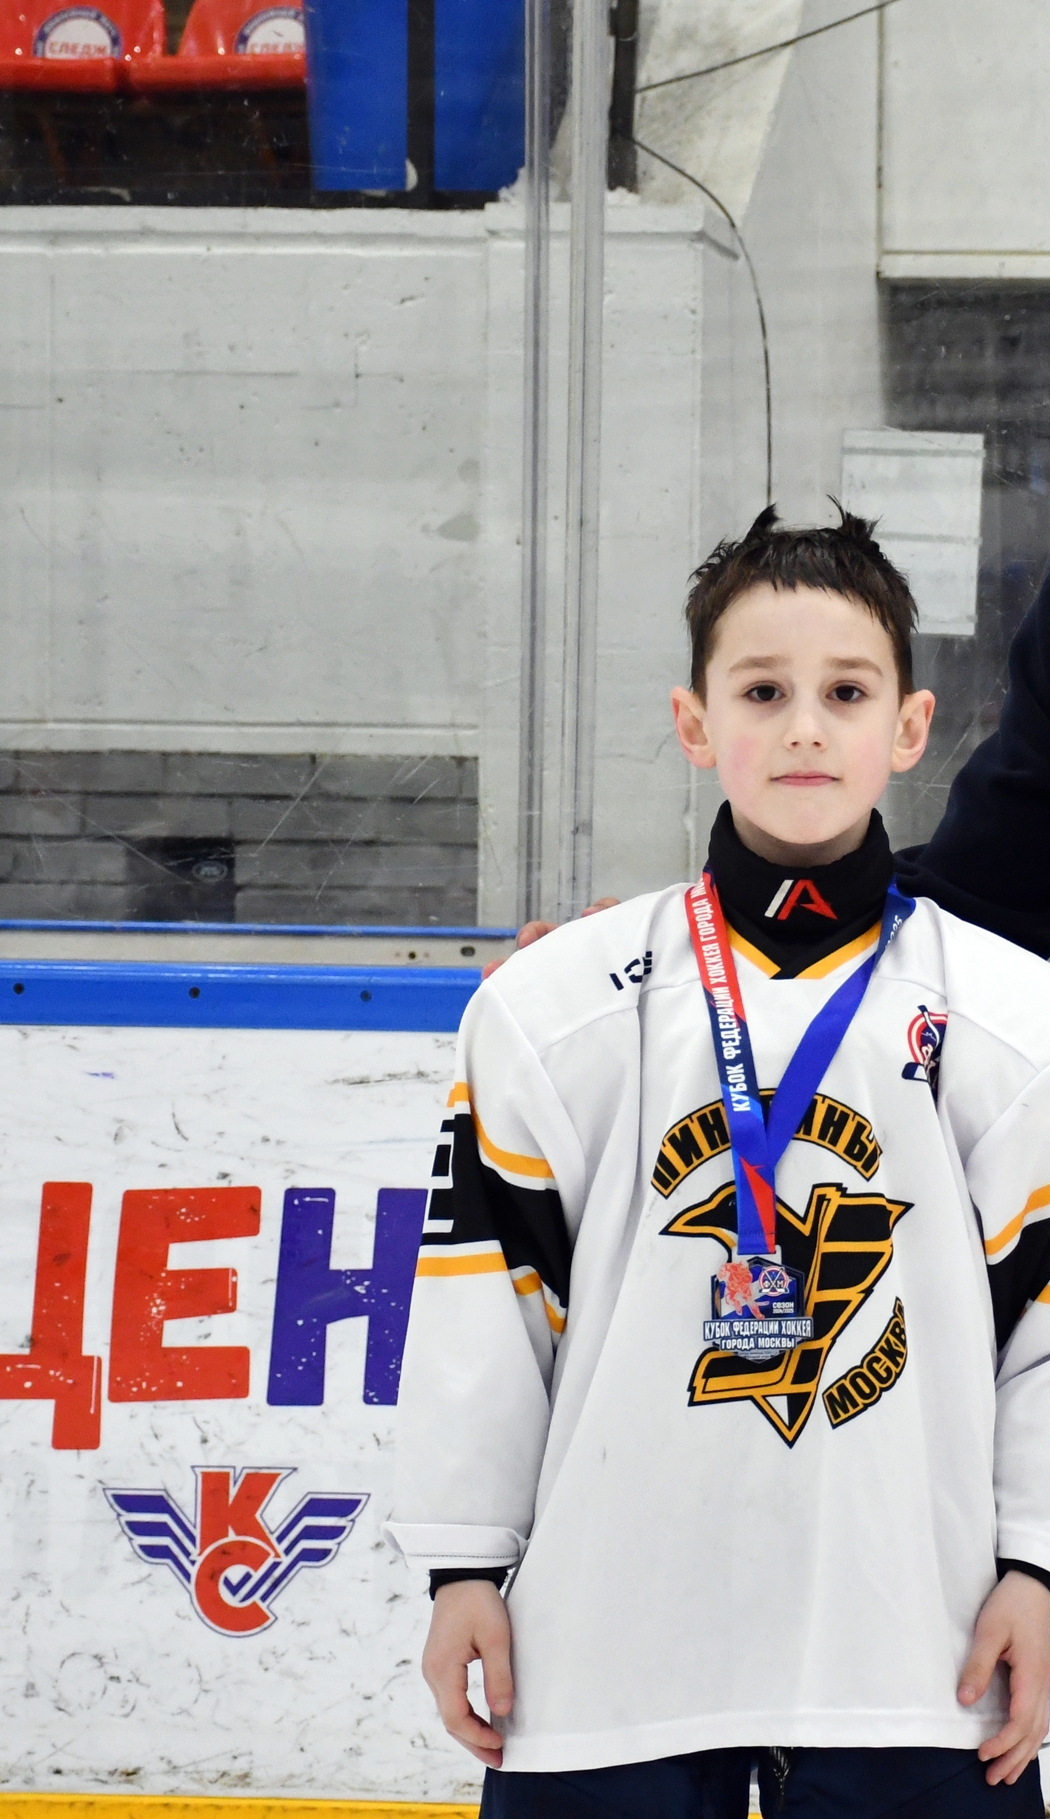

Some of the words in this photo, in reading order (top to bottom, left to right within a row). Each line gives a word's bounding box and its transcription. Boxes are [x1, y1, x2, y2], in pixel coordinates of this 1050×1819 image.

[692, 898, 717, 942] ГОРОДА
[701, 943, 727, 985] ХОККЕЯ
[711, 986, 742, 1060] ФЕДЕРАЦИИ
[725, 1063, 751, 1112] КУБОК
[652, 1095, 882, 1195] ПИННЫ
[704, 1321, 731, 1340] КУБОК
[732, 1320, 779, 1336] ФЕДЕРАЦИИ
[781, 1320, 811, 1337] ХОККЕЯ
[721, 1337, 755, 1350] ГОРОДА
[758, 1337, 795, 1348] МОСКВЫ
